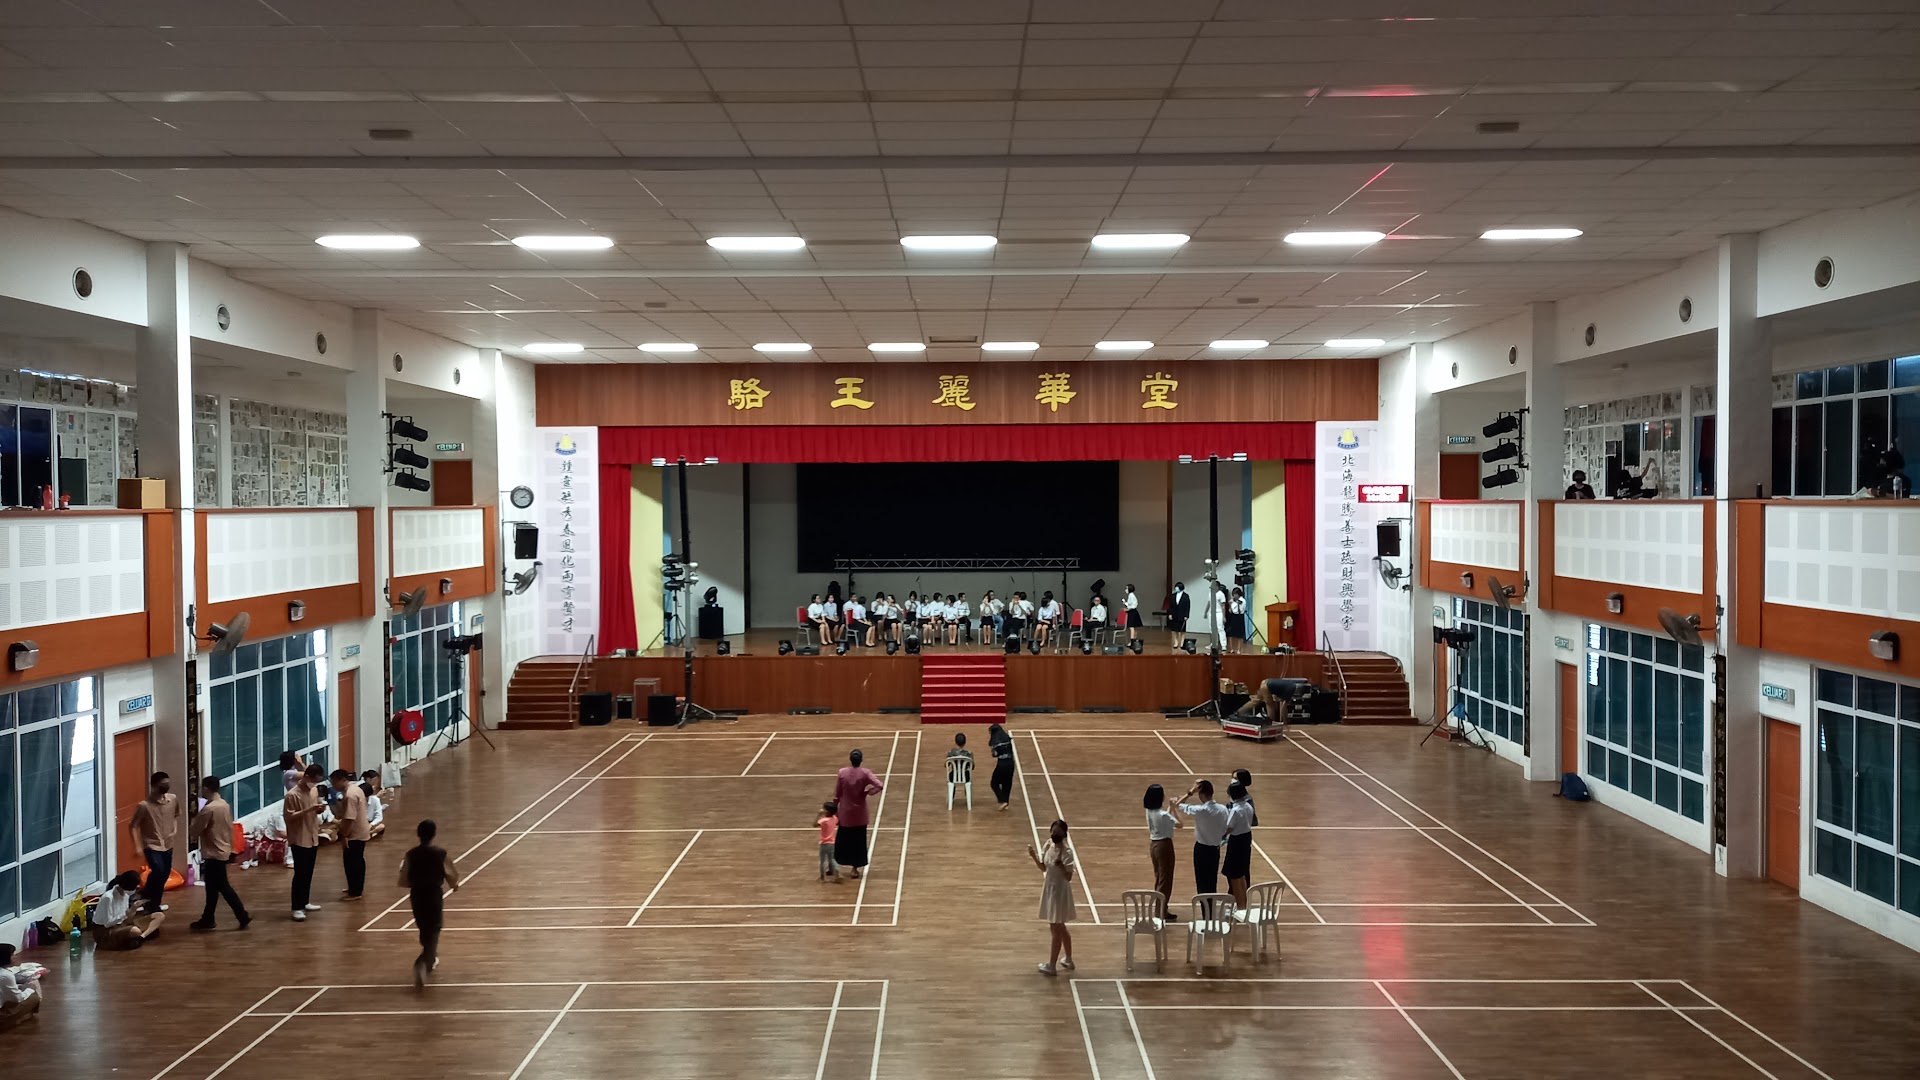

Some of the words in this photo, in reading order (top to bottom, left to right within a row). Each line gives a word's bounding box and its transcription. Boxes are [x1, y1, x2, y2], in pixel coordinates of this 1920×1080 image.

[727, 371, 1179, 412] 駱王麗華堂
